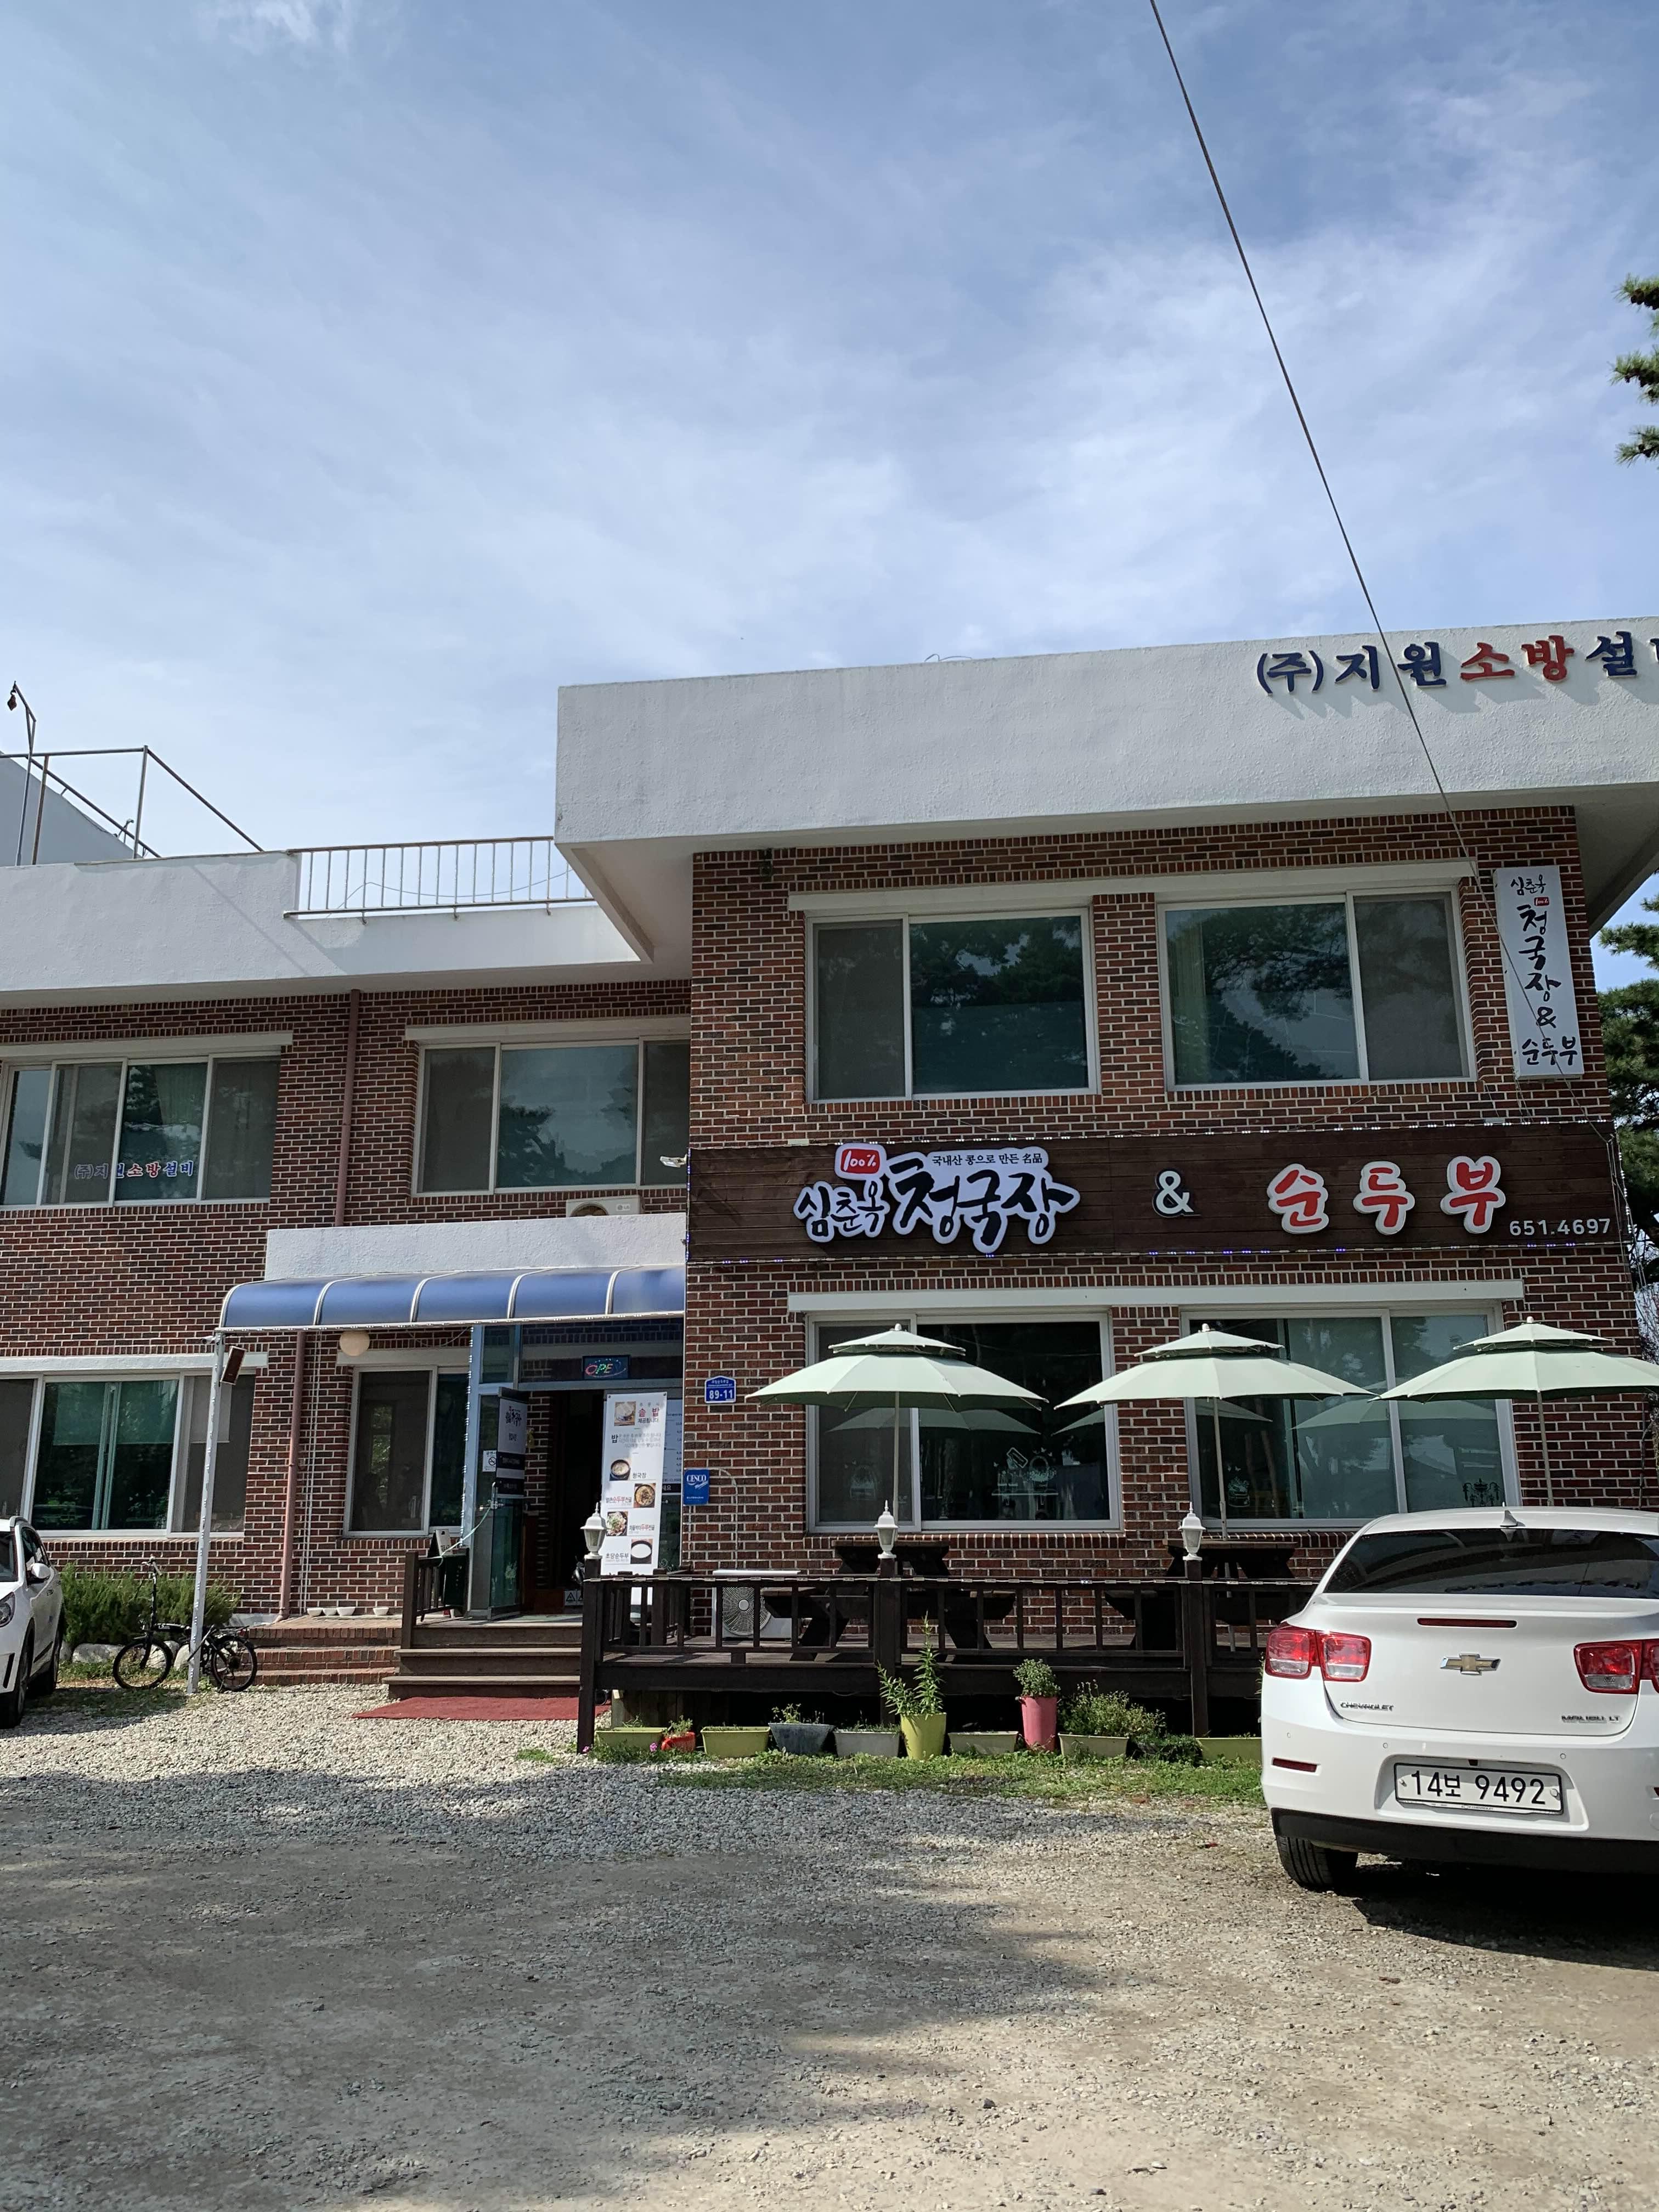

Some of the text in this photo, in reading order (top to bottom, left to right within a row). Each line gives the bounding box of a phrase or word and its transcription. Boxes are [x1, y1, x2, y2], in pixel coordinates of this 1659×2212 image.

[1257, 631, 1659, 695] (주)지원소방설
[1510, 874, 1547, 896] 심춘옥
[1517, 904, 1561, 1002] 청국장
[1536, 1006, 1556, 1029] &
[1521, 1035, 1578, 1066] 순두부
[842, 1149, 877, 1173] 100%
[932, 1154, 1019, 1166] 국내산 콩으로 만든
[1022, 1153, 1043, 1164] 名品
[797, 1158, 1073, 1246] 심춘옥 청국장
[1155, 1169, 1200, 1218] &
[1272, 1159, 1502, 1231] 순두부
[1509, 1217, 1611, 1237] 651.4697
[709, 1389, 733, 1400] 89-11
[686, 1474, 707, 1482] CESCO
[1340, 1702, 1394, 1712] CHEVROLET
[1411, 1770, 1547, 1805] 14보 9492
